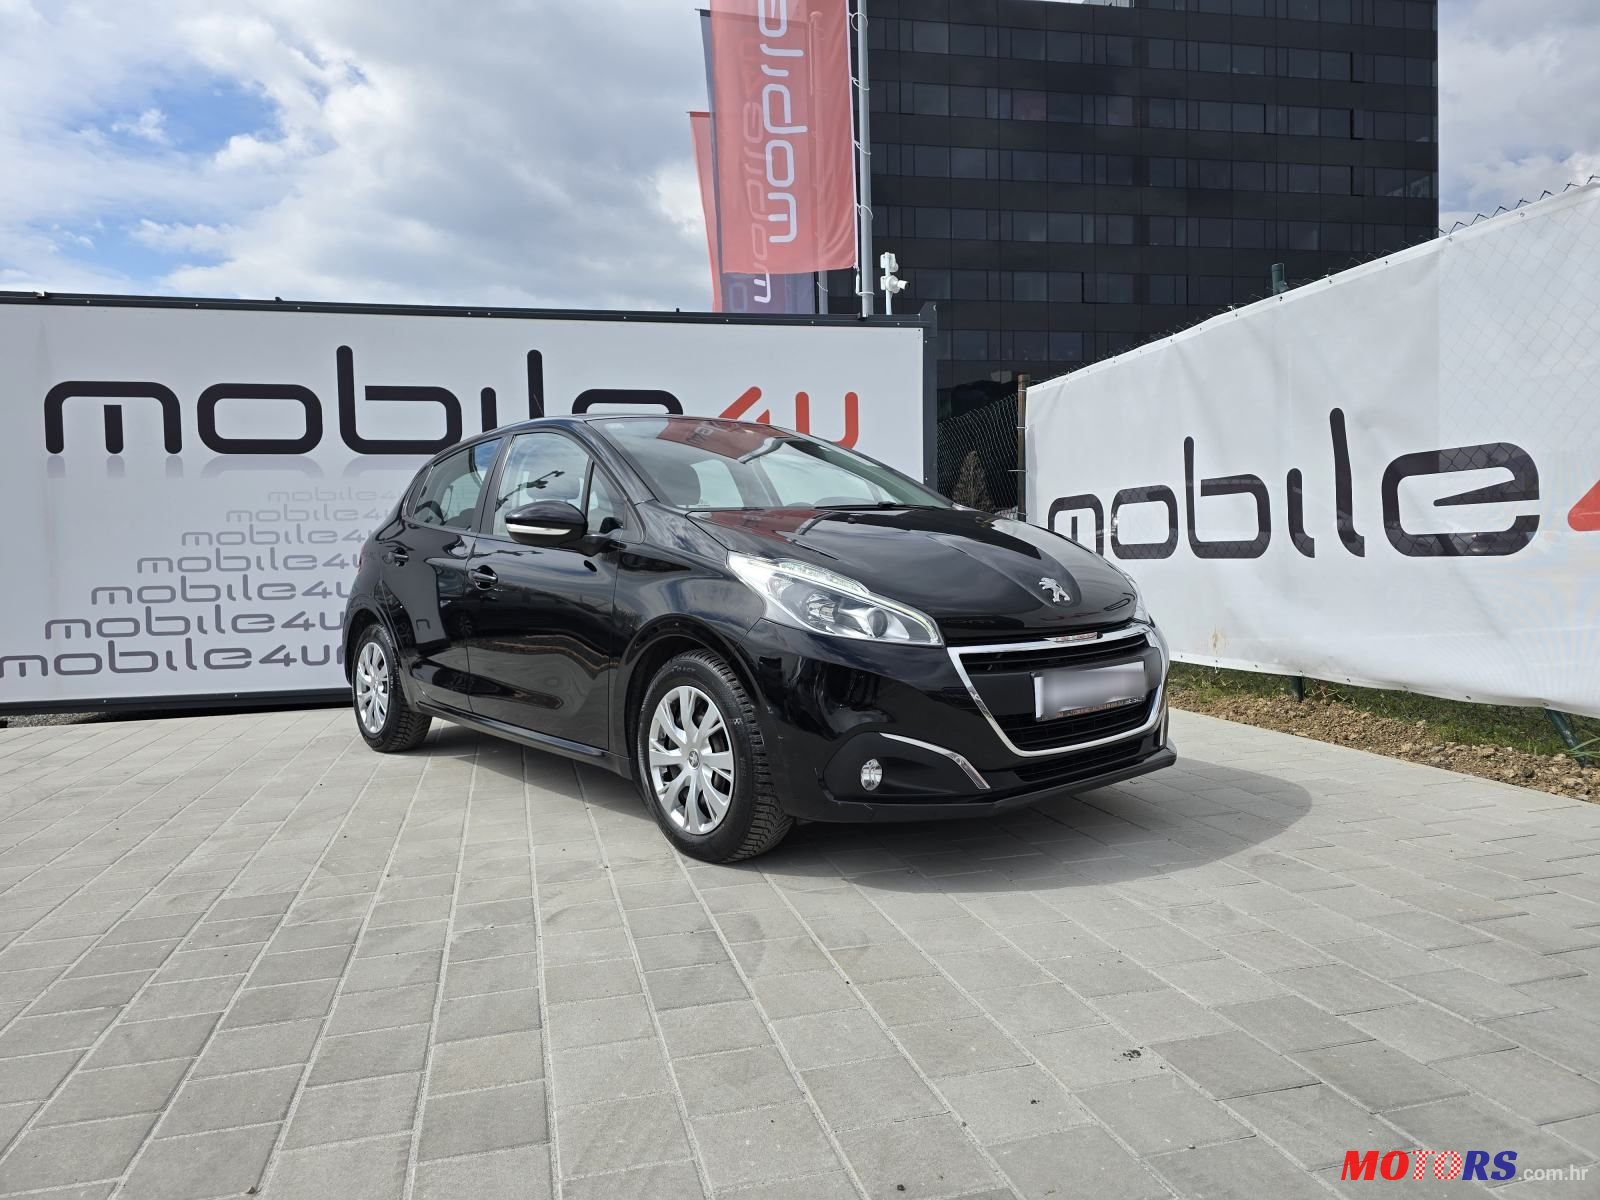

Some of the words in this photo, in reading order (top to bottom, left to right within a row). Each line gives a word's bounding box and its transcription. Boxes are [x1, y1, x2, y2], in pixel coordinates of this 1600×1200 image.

[268, 486, 401, 503] mobile4
[1048, 408, 1600, 559] mobile
[226, 503, 391, 523] mobile4
[181, 523, 372, 547] mobile4
[0, 637, 345, 679] mobile4u
